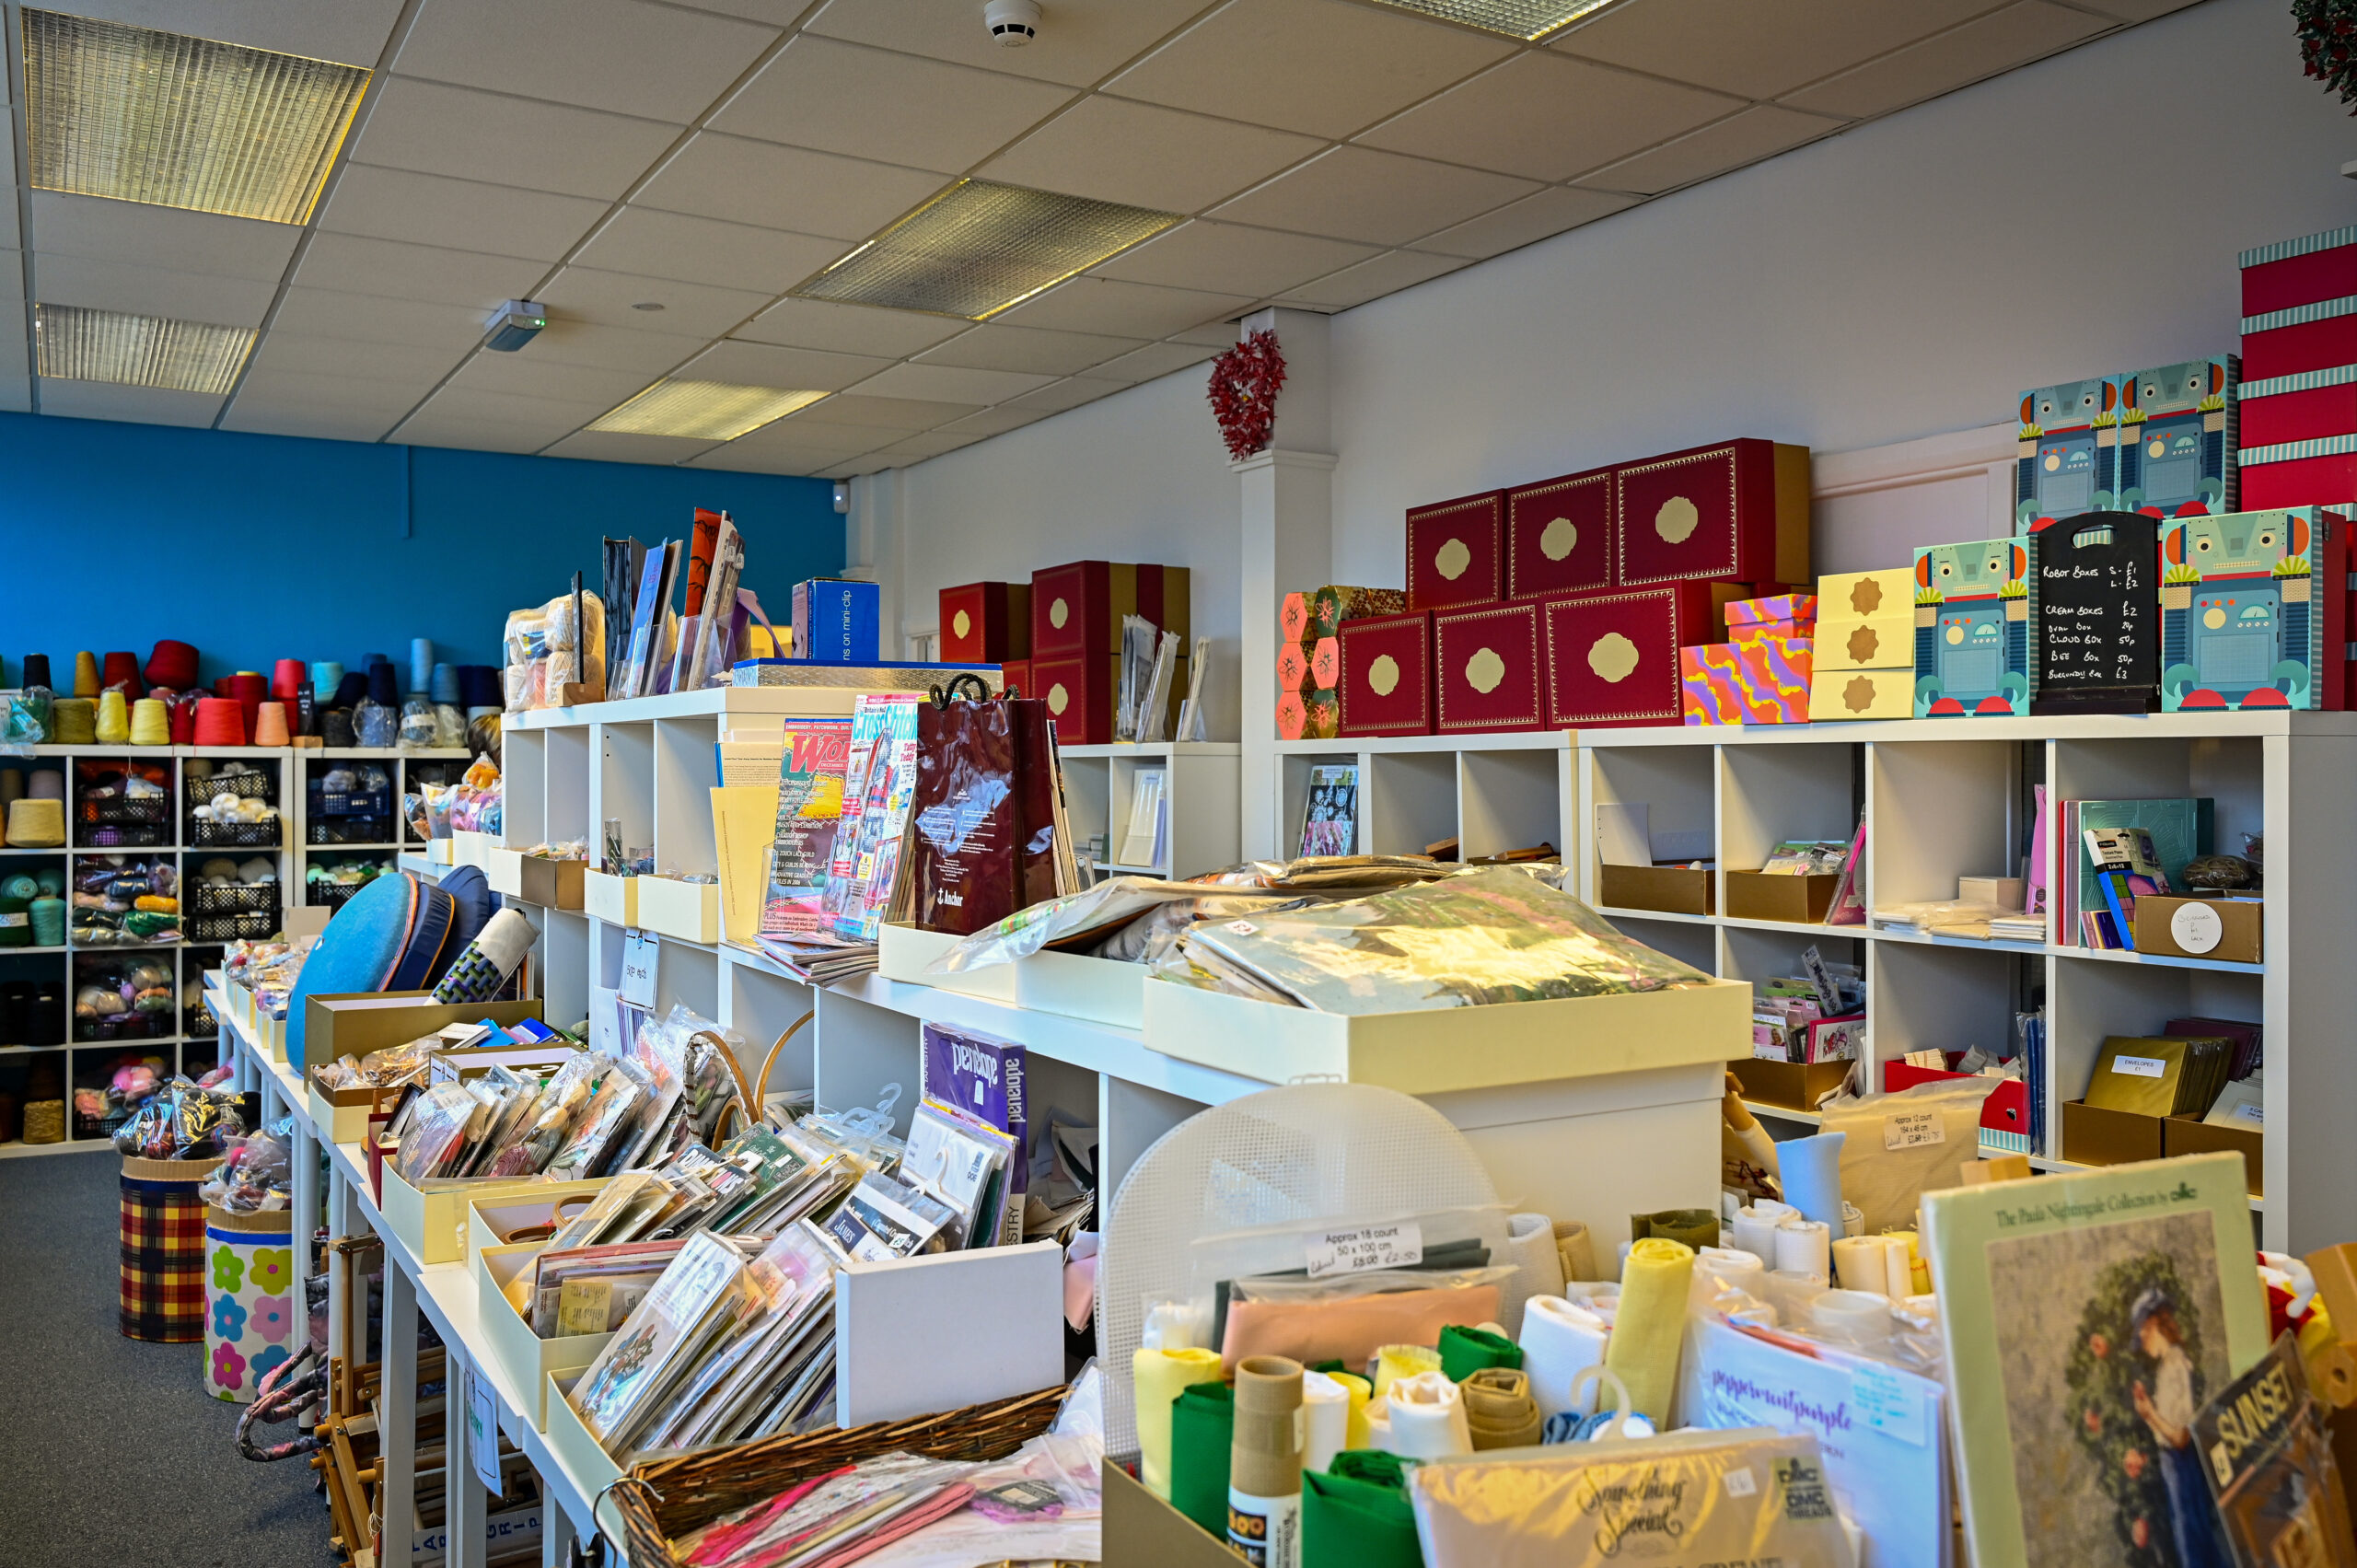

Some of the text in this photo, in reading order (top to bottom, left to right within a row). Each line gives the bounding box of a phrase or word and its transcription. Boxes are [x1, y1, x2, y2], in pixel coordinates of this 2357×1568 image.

[2043, 565, 2070, 578] ROBOT
[2073, 565, 2098, 578] BOXES
[2127, 562, 2136, 576] £1
[2126, 576, 2138, 589] £2
[842, 589, 852, 631] mini-clip
[2045, 600, 2137, 616] CREAM BOXES £2
[842, 633, 851, 646] on
[2049, 633, 2080, 644] CLOUD
[2051, 650, 2070, 661] BEE
[2116, 667, 2127, 679] £3
[945, 889, 963, 907] Anchor
[951, 1042, 998, 1088] penelope
[2124, 1059, 2154, 1067] ENVELOPES
[1005, 1058, 1027, 1122] penelope
[1996, 1210, 2015, 1227] The
[2017, 1206, 2045, 1225] Paula
[2048, 1198, 2105, 1224] Nightingale
[2107, 1192, 2155, 1212] Collection
[834, 1219, 855, 1244] JAMES
[1326, 1226, 1399, 1244] Approx 18 count
[1360, 1242, 1376, 1252] 100
[1377, 1241, 1392, 1251] cm
[1712, 1369, 1852, 1437] peppermintpurple
[2215, 1360, 2294, 1461] SUNSET
[1576, 1466, 1689, 1516] Something
[1785, 1492, 1827, 1508] DMC
[1785, 1505, 1833, 1518] THREADS
[1594, 1503, 1685, 1559] Special
